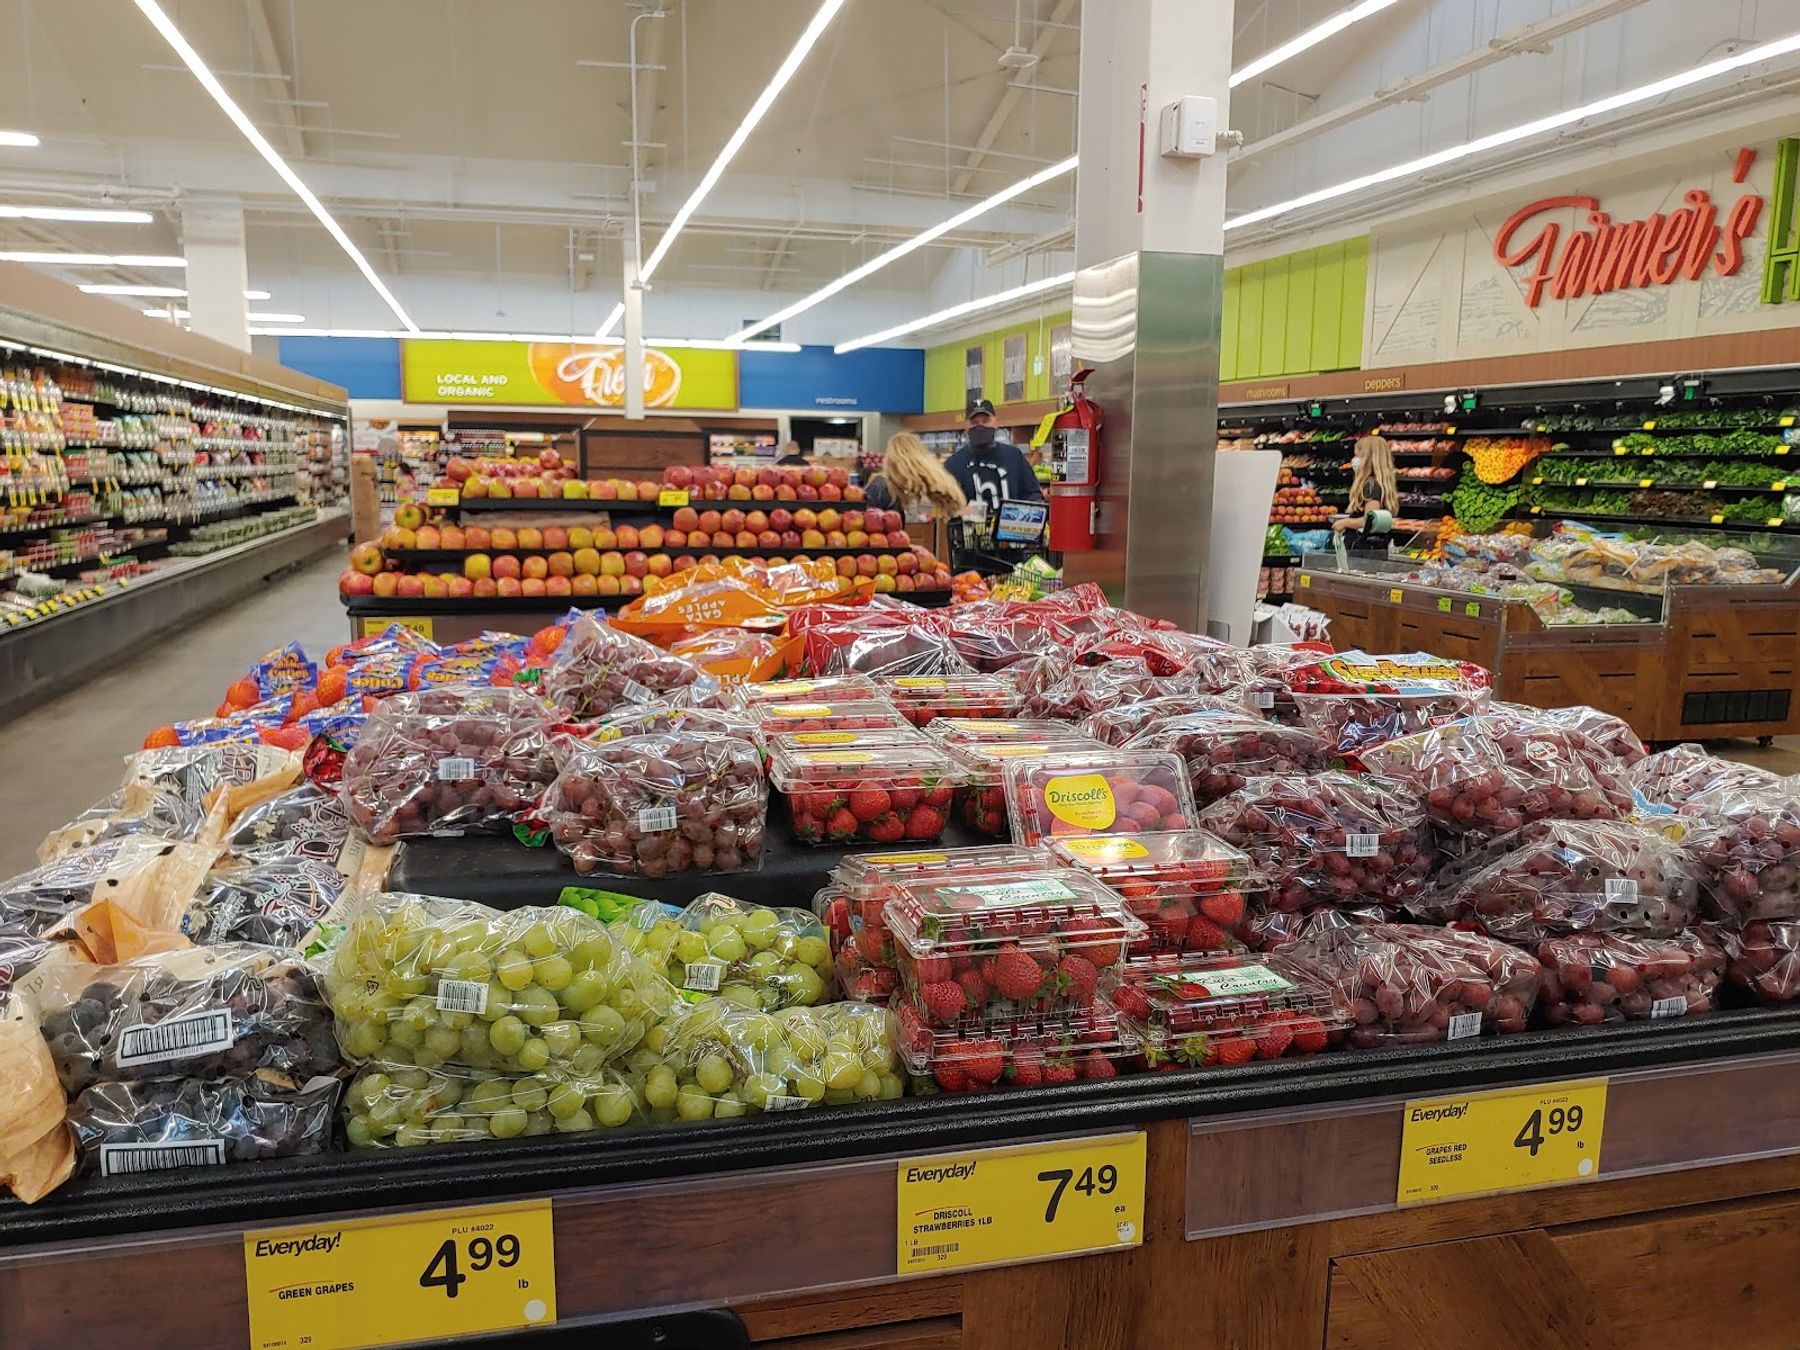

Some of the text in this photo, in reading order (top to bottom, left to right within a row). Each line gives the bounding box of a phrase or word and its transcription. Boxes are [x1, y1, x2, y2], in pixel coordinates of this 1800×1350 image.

[1494, 147, 1764, 308] Farmer's
[437, 373, 508, 386] LOCAL AND
[1364, 376, 1401, 391] peppers
[437, 386, 494, 398] ORGANIC
[1245, 387, 1287, 399] mushrooms
[677, 599, 726, 615] APPLES
[1049, 787, 1108, 803] Driscoll's
[1411, 1102, 1470, 1122] Everyday!
[1426, 1143, 1468, 1156] GRAPES RED
[1577, 1140, 1585, 1149] lb
[1428, 1153, 1463, 1165] SEEDLESS
[906, 1161, 977, 1183] Everyday!
[933, 1207, 973, 1220] DRISCOLL
[1114, 1205, 1126, 1213] ea
[452, 1226, 468, 1235] PLU
[913, 1218, 976, 1234] STRAWBERRIES
[255, 1232, 342, 1258] Everyday!
[518, 1278, 529, 1290] lb
[278, 1282, 355, 1300] GREEN GRAPES
